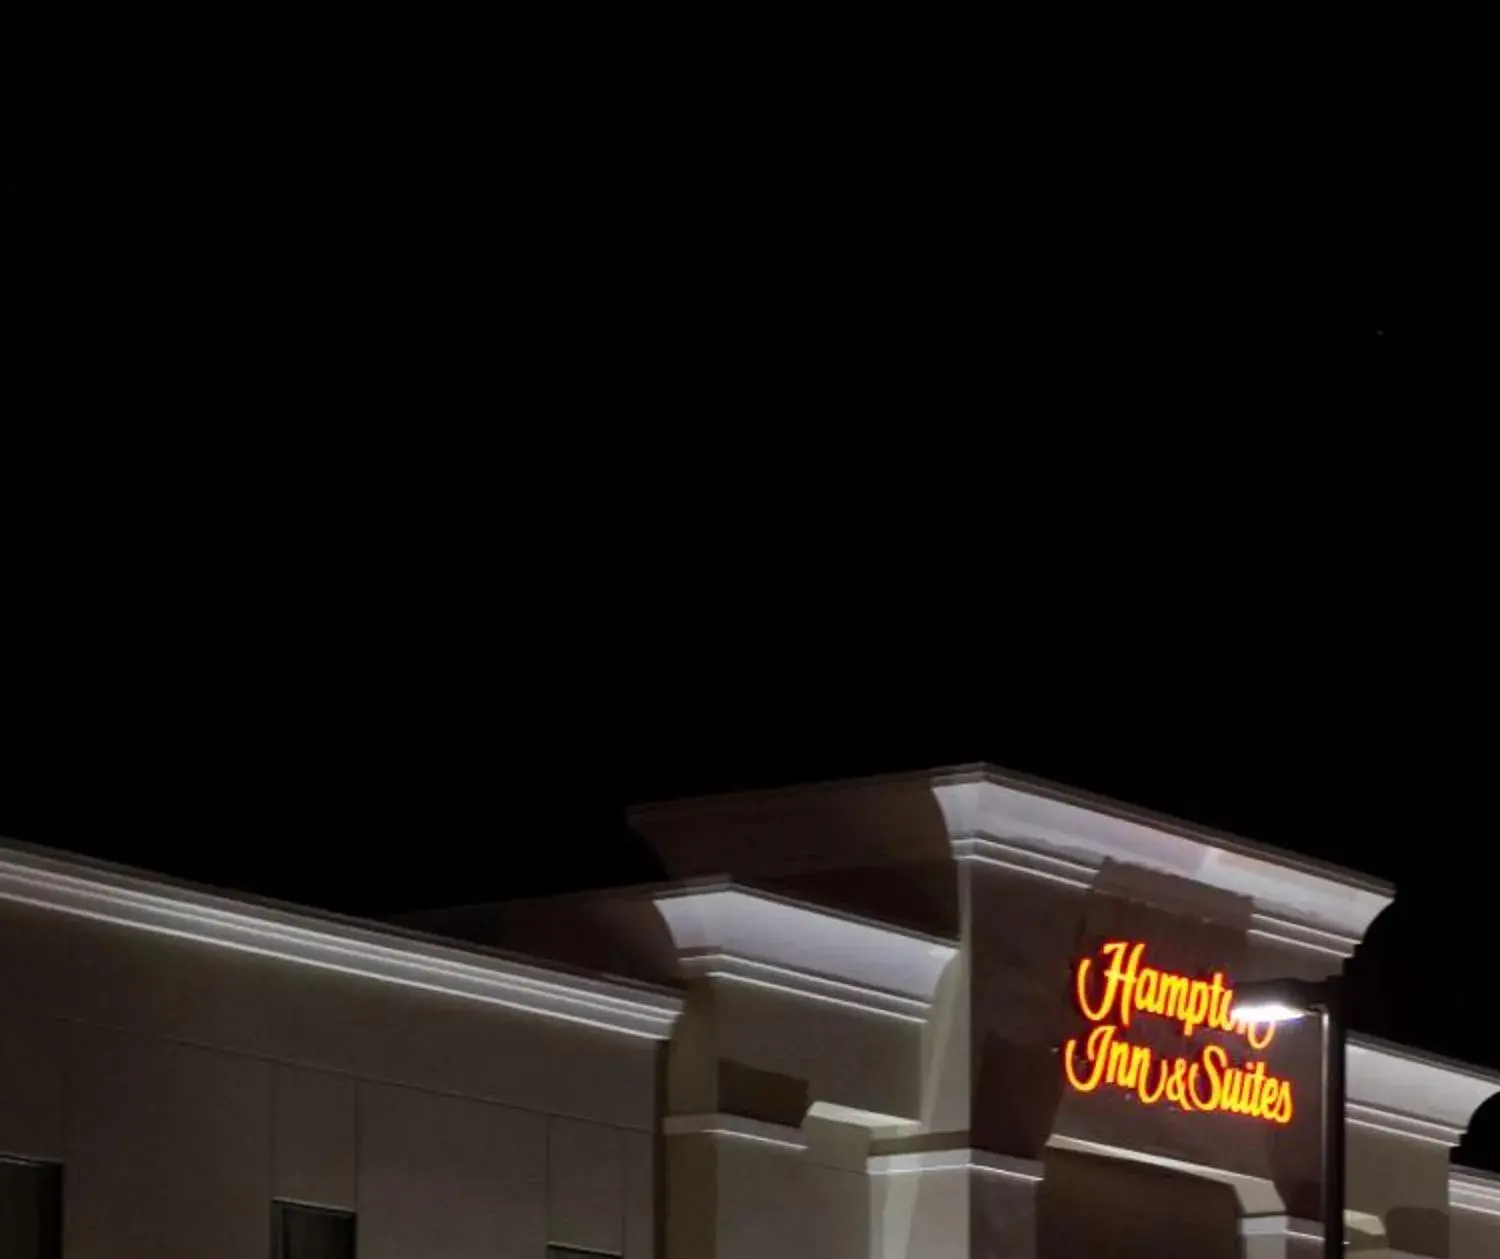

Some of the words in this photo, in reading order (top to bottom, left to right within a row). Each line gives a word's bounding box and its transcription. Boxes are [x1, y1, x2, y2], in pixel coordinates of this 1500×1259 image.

[1065, 1025, 1167, 1104] Inn
[1166, 1057, 1193, 1111] &
[1188, 1045, 1292, 1123] Suites
